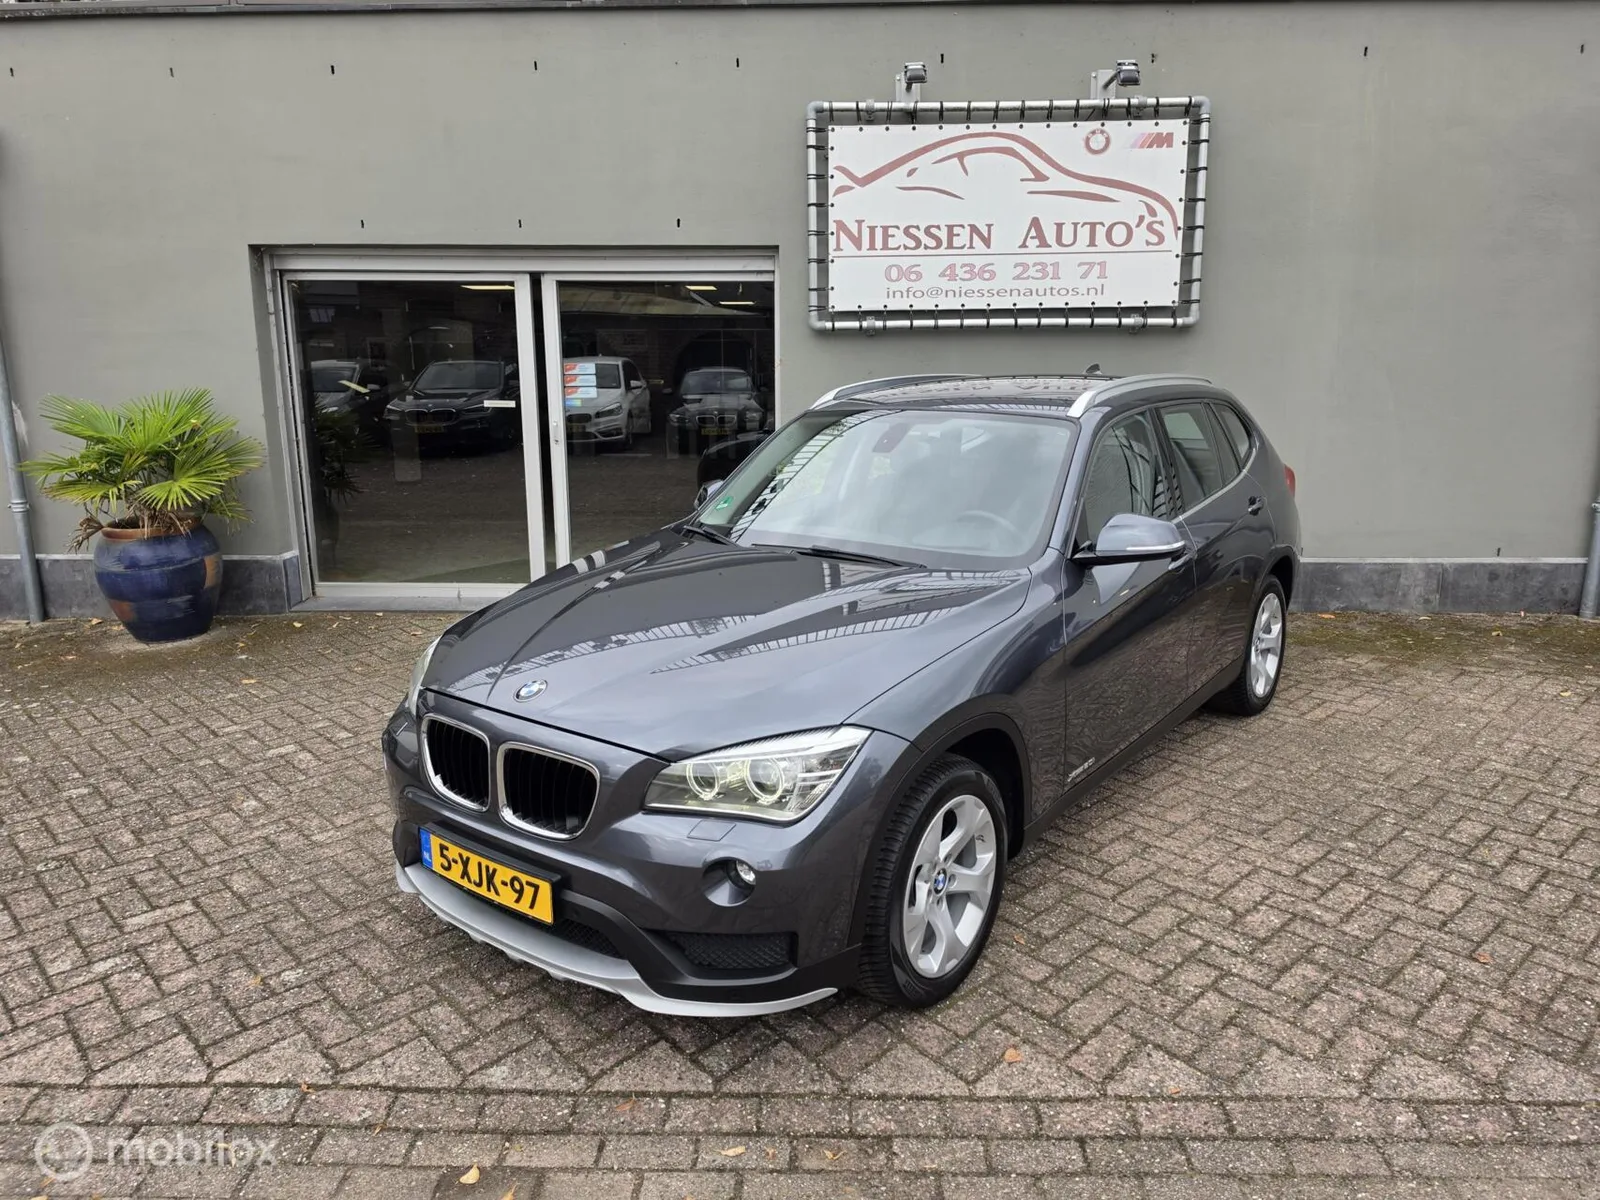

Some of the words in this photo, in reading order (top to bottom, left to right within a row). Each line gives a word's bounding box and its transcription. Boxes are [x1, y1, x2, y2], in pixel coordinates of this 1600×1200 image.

[833, 219, 994, 252] NIESSEN
[1017, 214, 1166, 249] AUTO'S
[884, 264, 923, 283] 06
[938, 262, 997, 282] 436
[1012, 261, 1061, 281] 231
[1077, 260, 1109, 280] 71
[886, 283, 1105, 300] info@niessenautos.nl
[438, 842, 541, 911] 5-XJK-97
